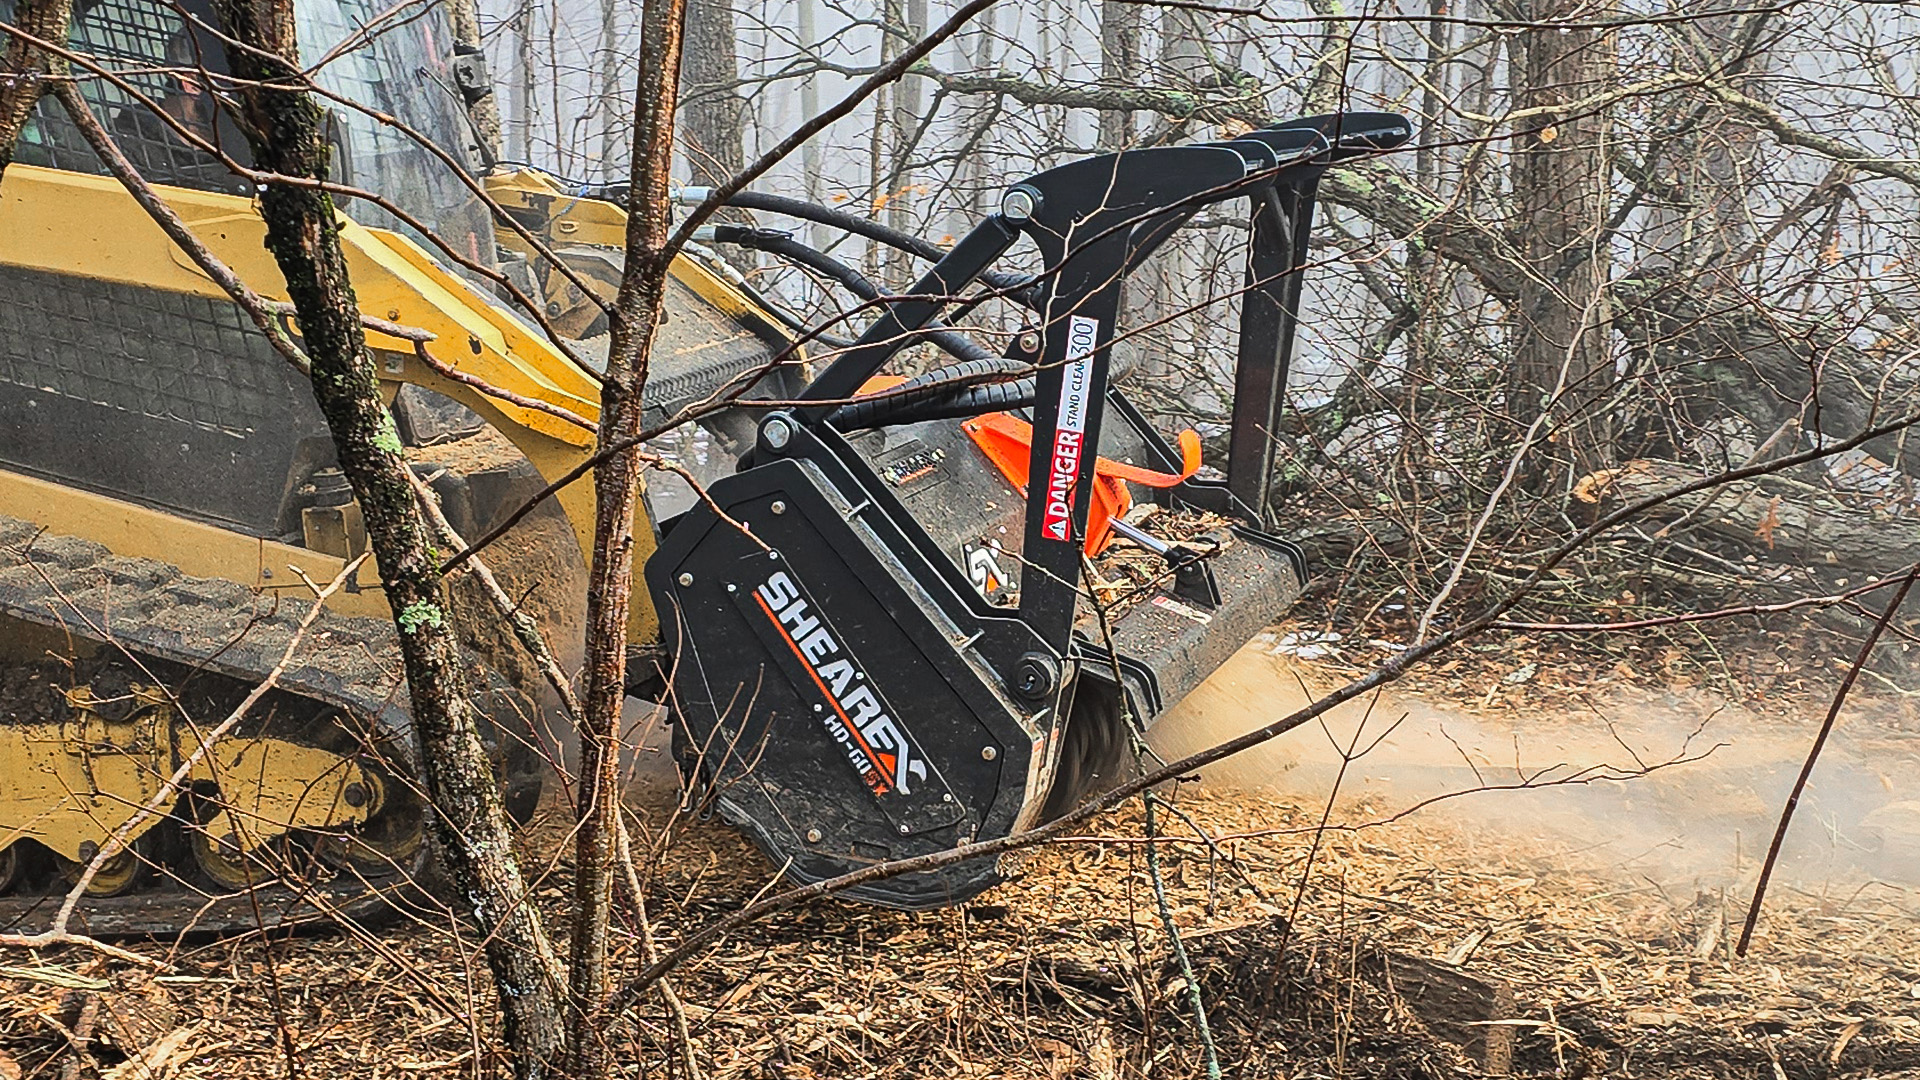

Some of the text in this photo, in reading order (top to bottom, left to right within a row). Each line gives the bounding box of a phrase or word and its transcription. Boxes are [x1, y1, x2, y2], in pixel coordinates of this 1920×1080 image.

[1070, 359, 1085, 391] CLEAR
[1066, 394, 1080, 426] STAND
[1048, 431, 1080, 517] DANGER
[758, 571, 927, 794] SHEAREX
